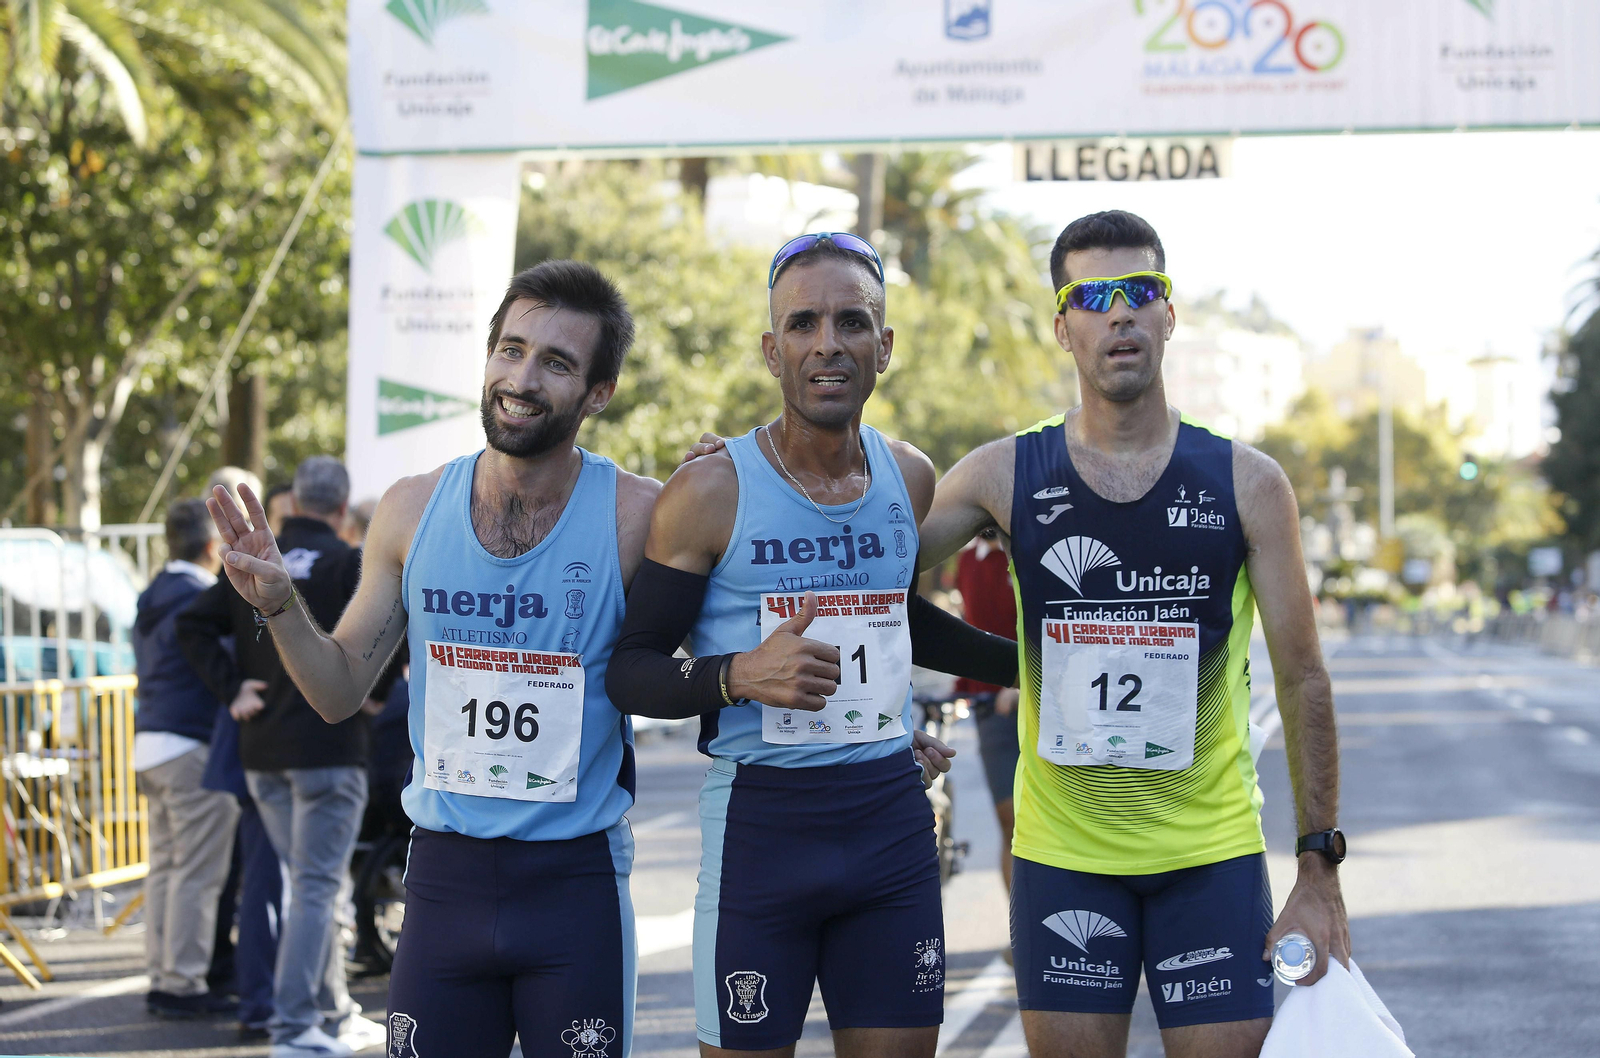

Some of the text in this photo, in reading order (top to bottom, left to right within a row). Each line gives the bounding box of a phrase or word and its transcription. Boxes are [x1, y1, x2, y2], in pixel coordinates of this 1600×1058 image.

[1026, 144, 1220, 181] LLEGADA
[1190, 507, 1225, 526] Jaén
[751, 525, 885, 570] nerja
[775, 572, 870, 592] ATLETISMO
[1116, 565, 1211, 596] Unicaja
[422, 584, 549, 628] nerja
[766, 596, 796, 619] 41
[798, 594, 859, 608] CRRERA
[862, 593, 905, 606] URBANA
[842, 607, 852, 616] DE
[854, 605, 891, 616] MÁLAGA
[1064, 604, 1190, 622] Fundación Jaén
[441, 626, 528, 645] ATLETISMO
[1046, 623, 1196, 644] 41 CARRERA URBANA
[1073, 635, 1175, 647] CIUDAD DE MÁLAGA
[430, 644, 582, 668] 41 CARRERA URBANA
[1144, 652, 1190, 661] FEDERADO
[457, 659, 559, 676] CIUDAD DE MÁLAGA
[527, 680, 574, 690] FEDERADO
[1091, 672, 1143, 712] 12
[461, 698, 540, 743] 196
[1050, 956, 1120, 977] Unicaja
[1043, 974, 1123, 990] Fundación Jaén
[1186, 976, 1232, 997] Jaén
[571, 1018, 606, 1030] CMD
